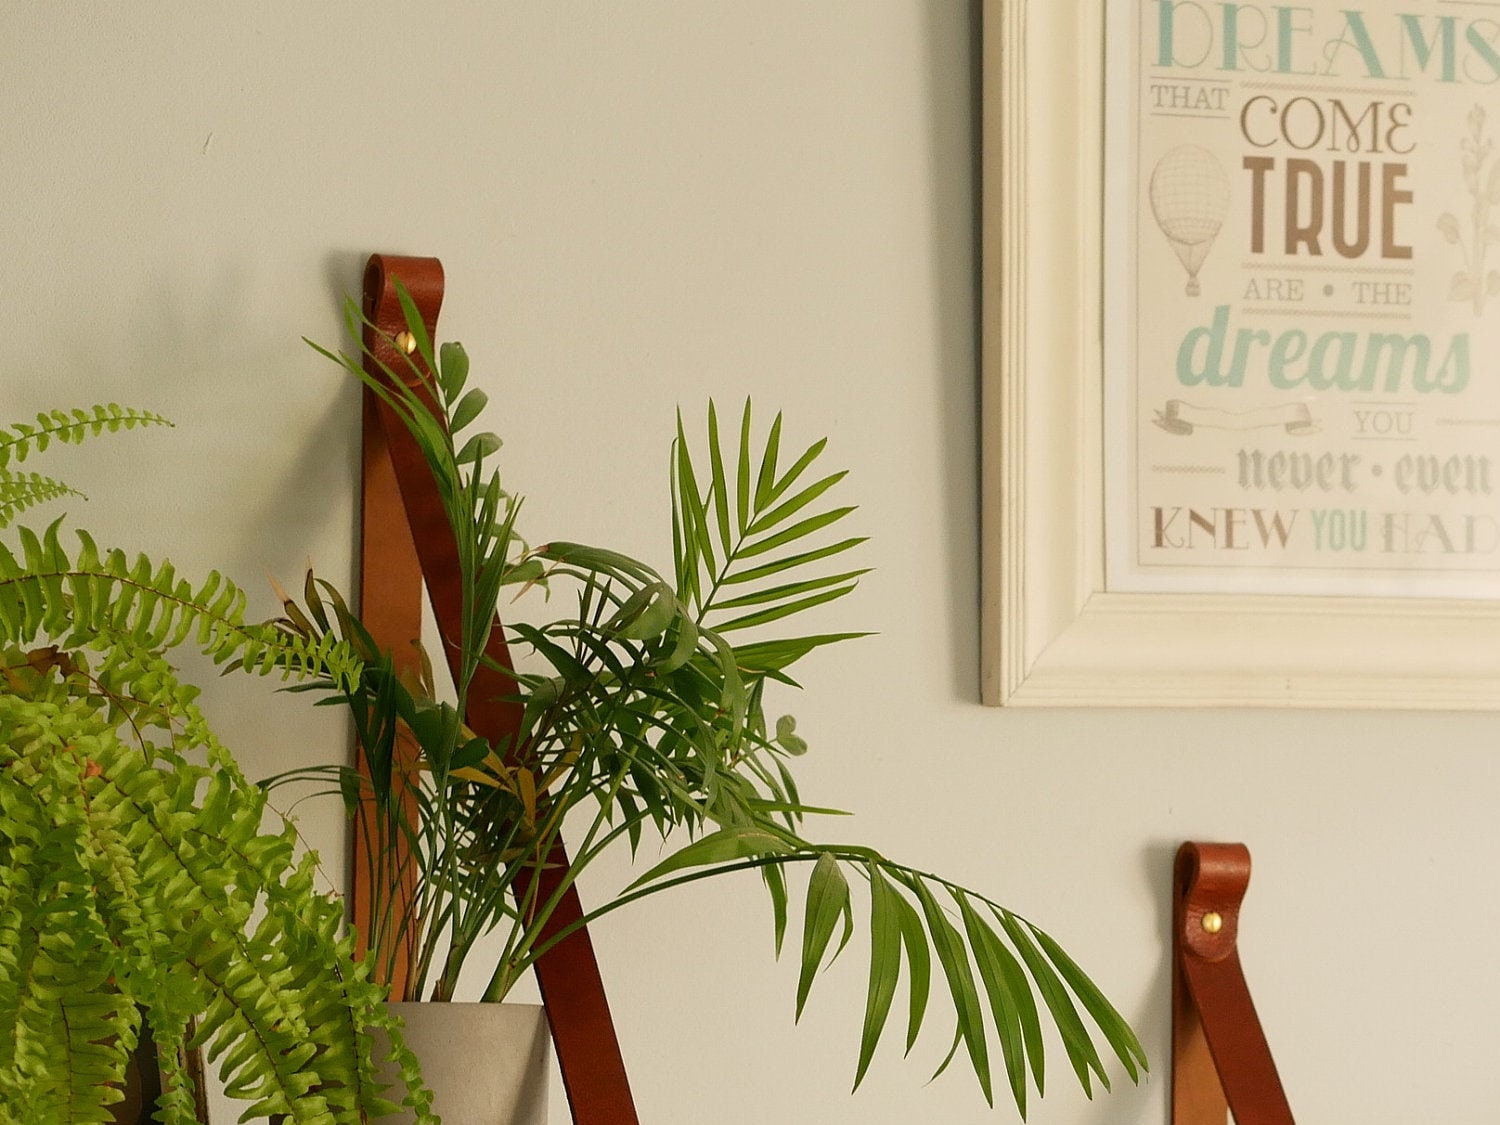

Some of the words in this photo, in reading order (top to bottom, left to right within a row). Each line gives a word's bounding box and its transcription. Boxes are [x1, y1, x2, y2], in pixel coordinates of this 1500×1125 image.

[1150, 84, 1230, 111] THAT
[1240, 95, 1417, 153] COME
[1242, 156, 1414, 260] TRUE
[1242, 278, 1305, 302] ARE
[1351, 281, 1412, 305] THE
[1176, 305, 1471, 394] dreams
[1352, 410, 1414, 435] YOU
[1236, 448, 1362, 493] never
[1394, 452, 1494, 495] even
[1150, 506, 1298, 550] KNEW
[1310, 508, 1368, 552] YOU
[1381, 513, 1500, 554] HAD
